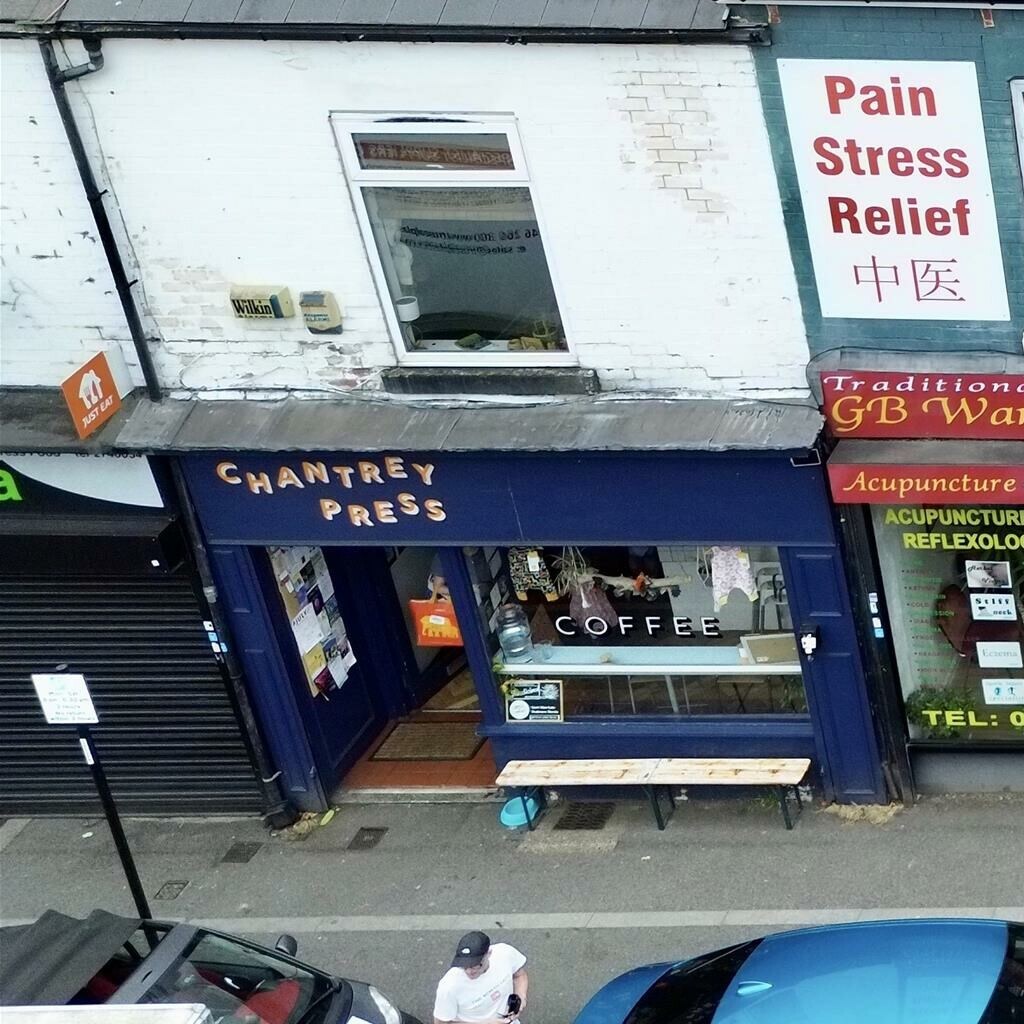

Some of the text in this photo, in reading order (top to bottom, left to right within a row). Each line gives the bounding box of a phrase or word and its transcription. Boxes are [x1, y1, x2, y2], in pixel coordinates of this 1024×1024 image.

[824, 75, 937, 116] Pain
[813, 136, 969, 178] Stress
[828, 196, 970, 236] Relief
[853, 255, 966, 303] 中医
[231, 299, 273, 315] Wilkin
[82, 395, 114, 428] JUST EAT
[831, 395, 908, 432] GB
[216, 456, 435, 495] CHANTREY
[843, 471, 1018, 498] Acupuncture
[320, 492, 447, 527] PRESS
[555, 615, 721, 636] COFFEE
[922, 710, 998, 726] TEL:
